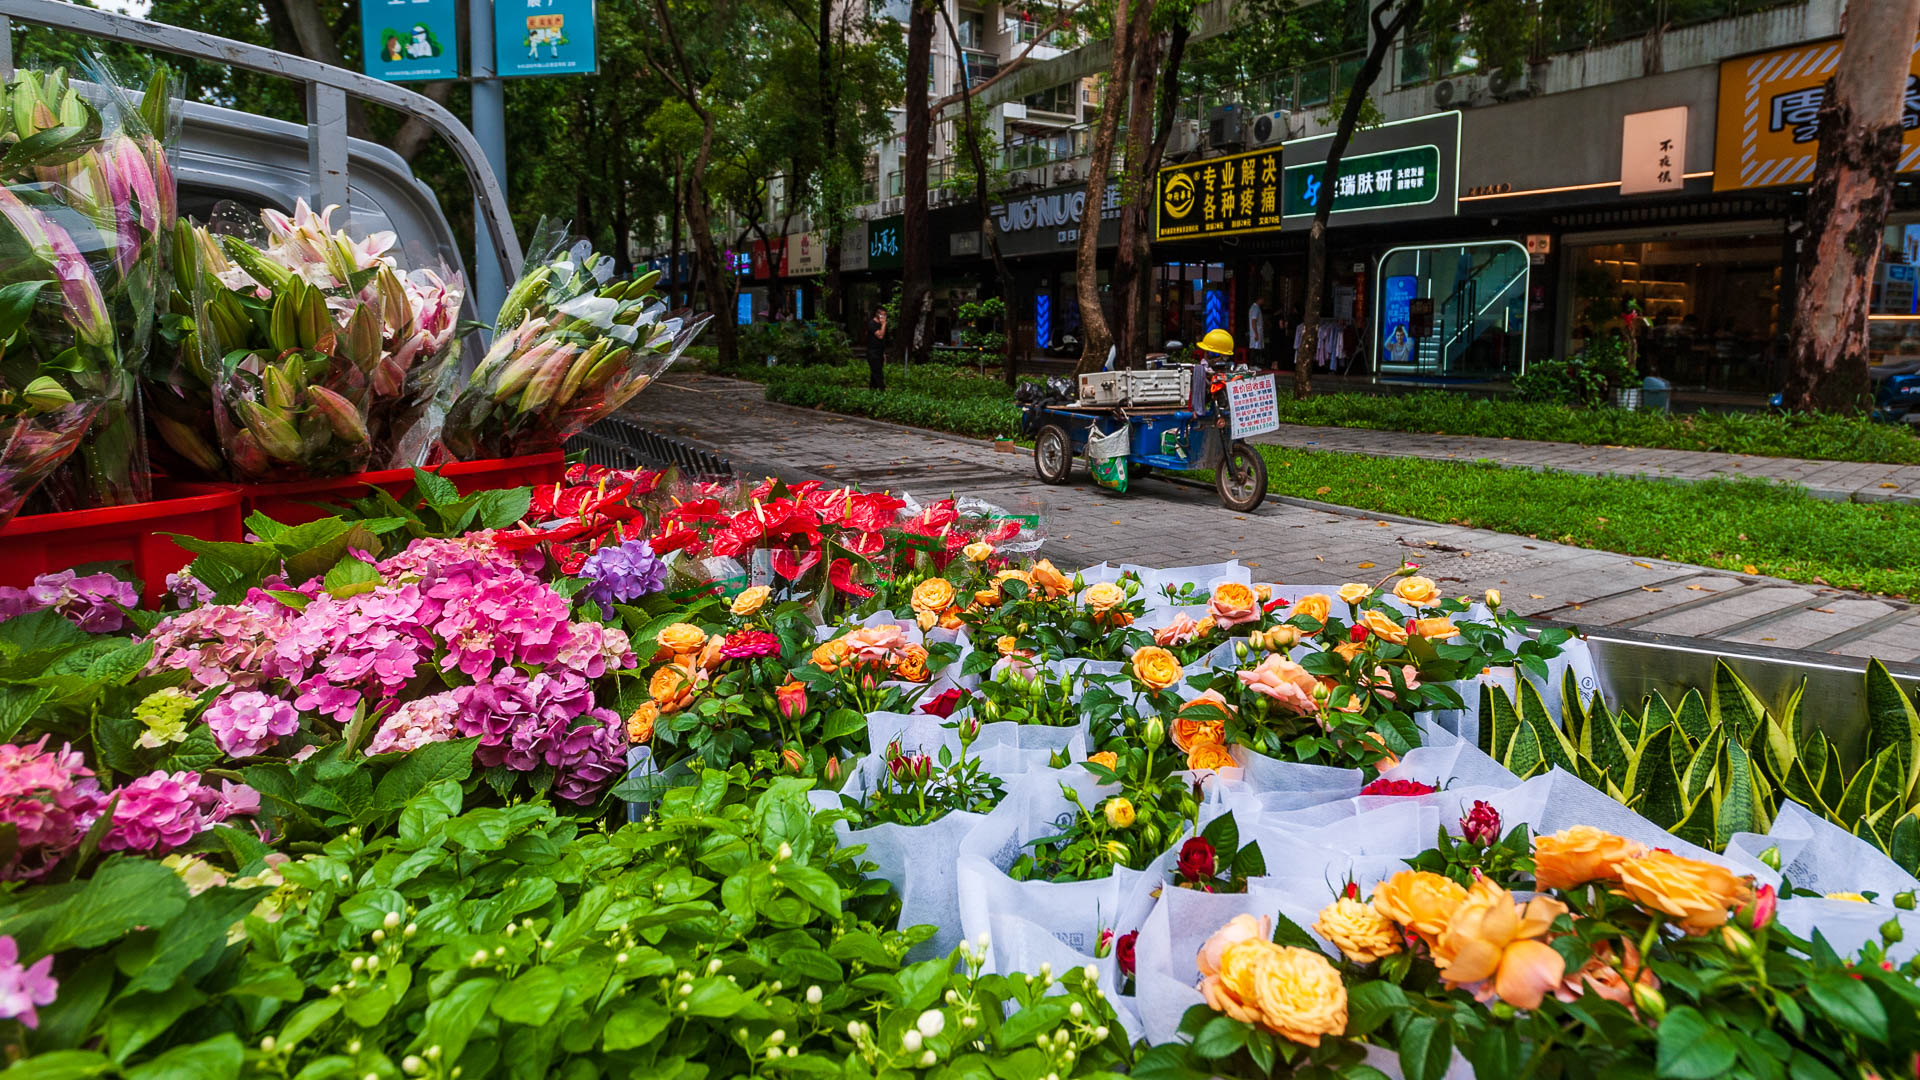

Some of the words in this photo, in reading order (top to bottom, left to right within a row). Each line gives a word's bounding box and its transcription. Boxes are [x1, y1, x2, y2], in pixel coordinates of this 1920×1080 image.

[1203, 155, 1277, 193] 专业解决
[1334, 169, 1393, 198] 瑞肤研
[1203, 184, 1277, 220] 各种疼痛
[1232, 380, 1272, 395] 高价回收废品
